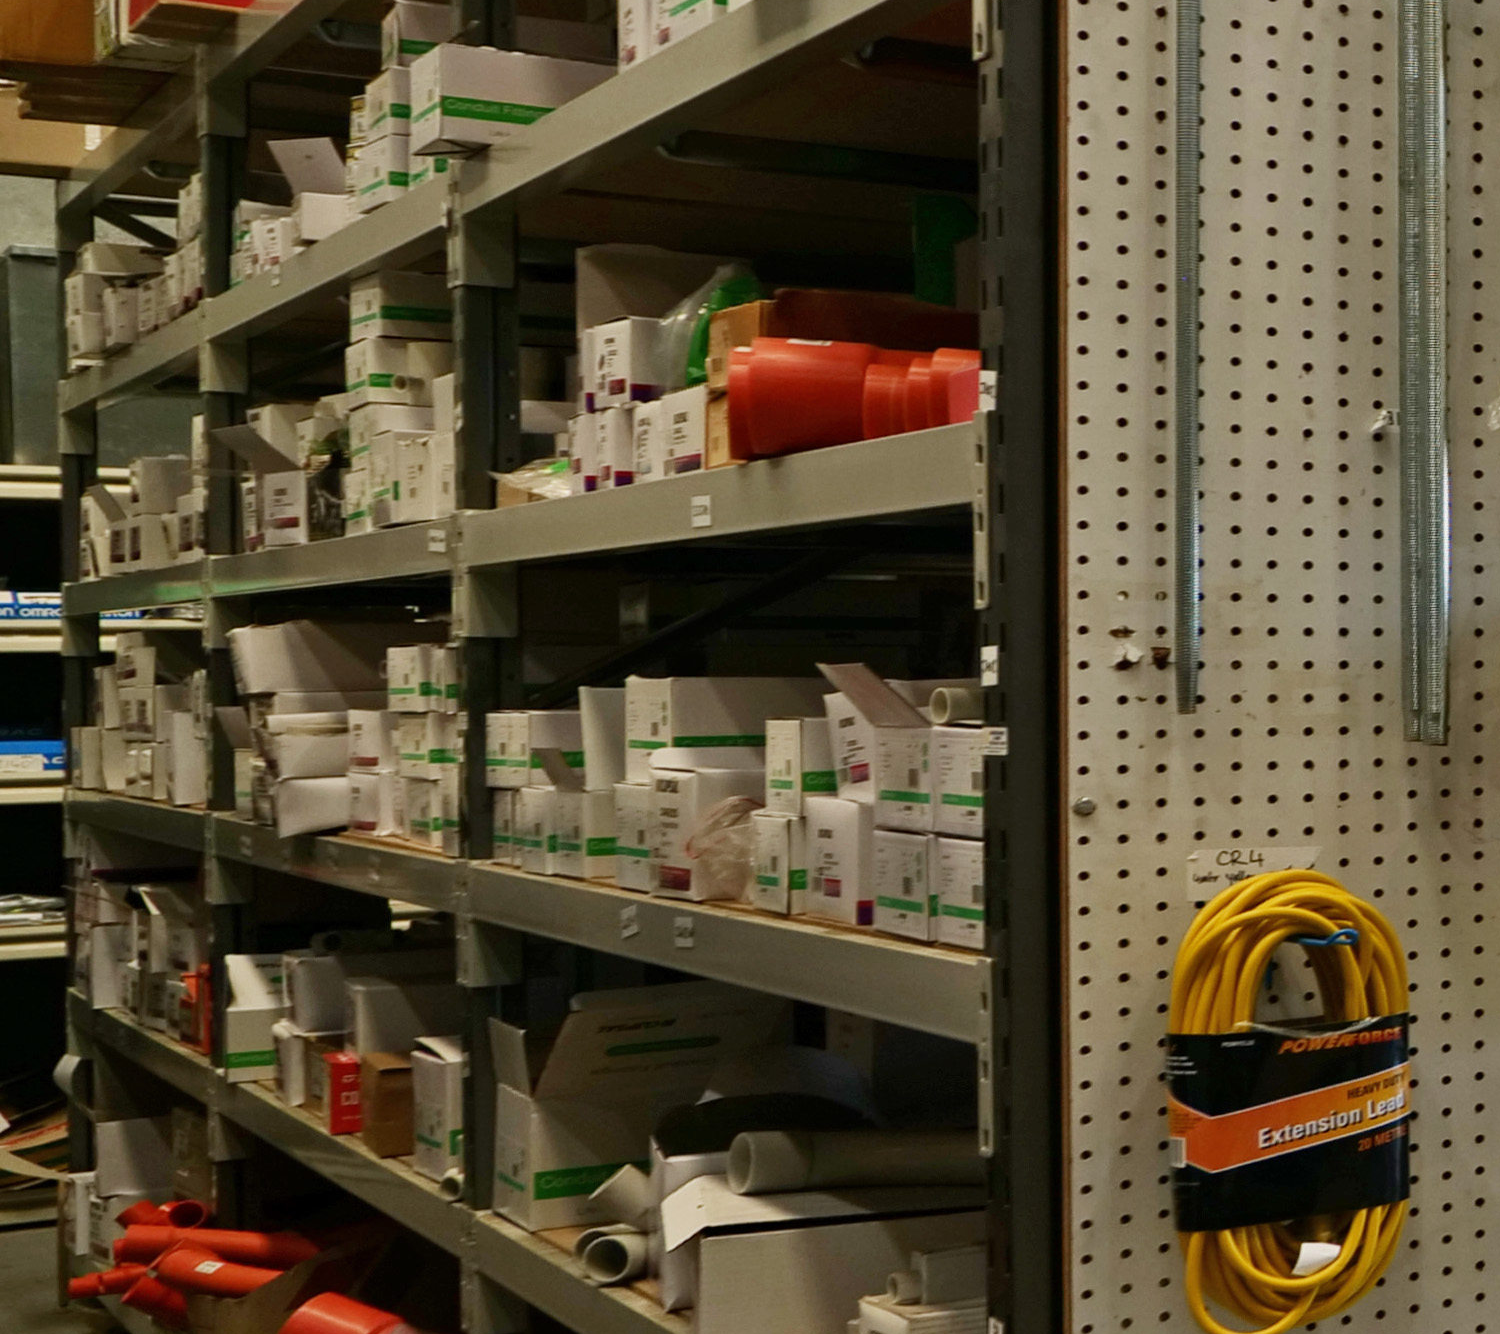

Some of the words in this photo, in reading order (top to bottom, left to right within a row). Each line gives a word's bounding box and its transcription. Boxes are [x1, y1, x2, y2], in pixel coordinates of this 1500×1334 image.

[1278, 1026, 1404, 1055] POWERFORCE
[1346, 1080, 1382, 1100] HEAVY
[1381, 1071, 1407, 1093] DUTY
[1257, 1105, 1363, 1150] Extension
[1366, 1088, 1405, 1121] Lead
[1357, 1137, 1374, 1153] 20
